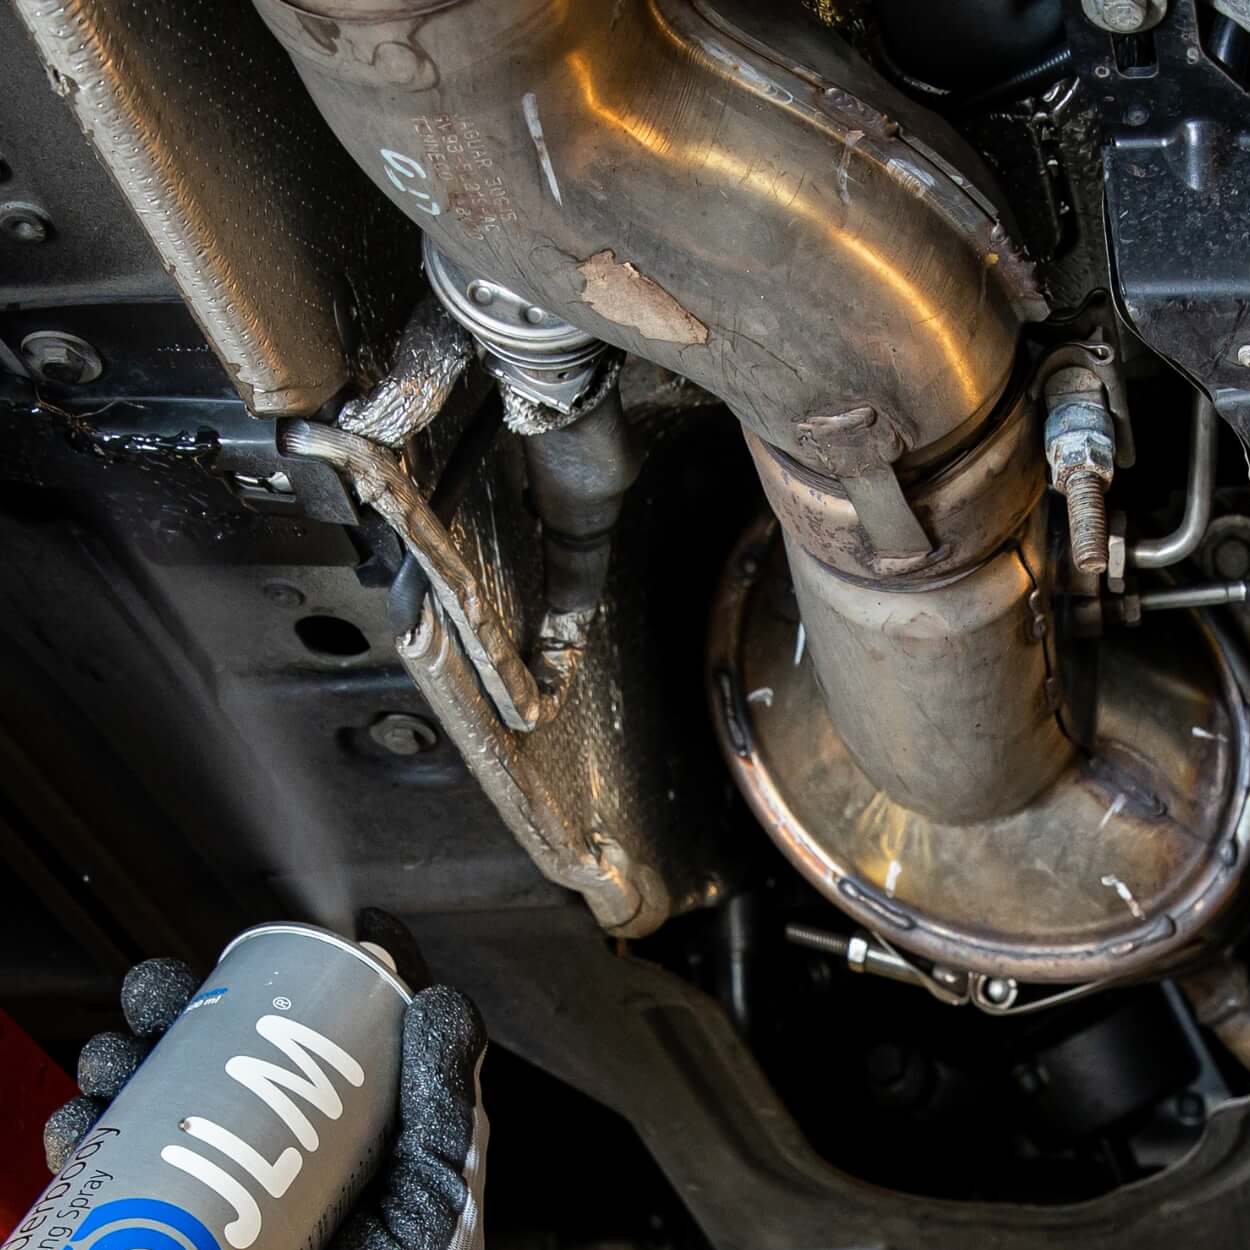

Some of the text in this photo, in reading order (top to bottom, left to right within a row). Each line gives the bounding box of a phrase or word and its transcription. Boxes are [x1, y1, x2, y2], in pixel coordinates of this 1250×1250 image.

[456, 114, 494, 169] AGUAR
[160, 1013, 366, 1250] JLM
[56, 1169, 114, 1219] Spray
